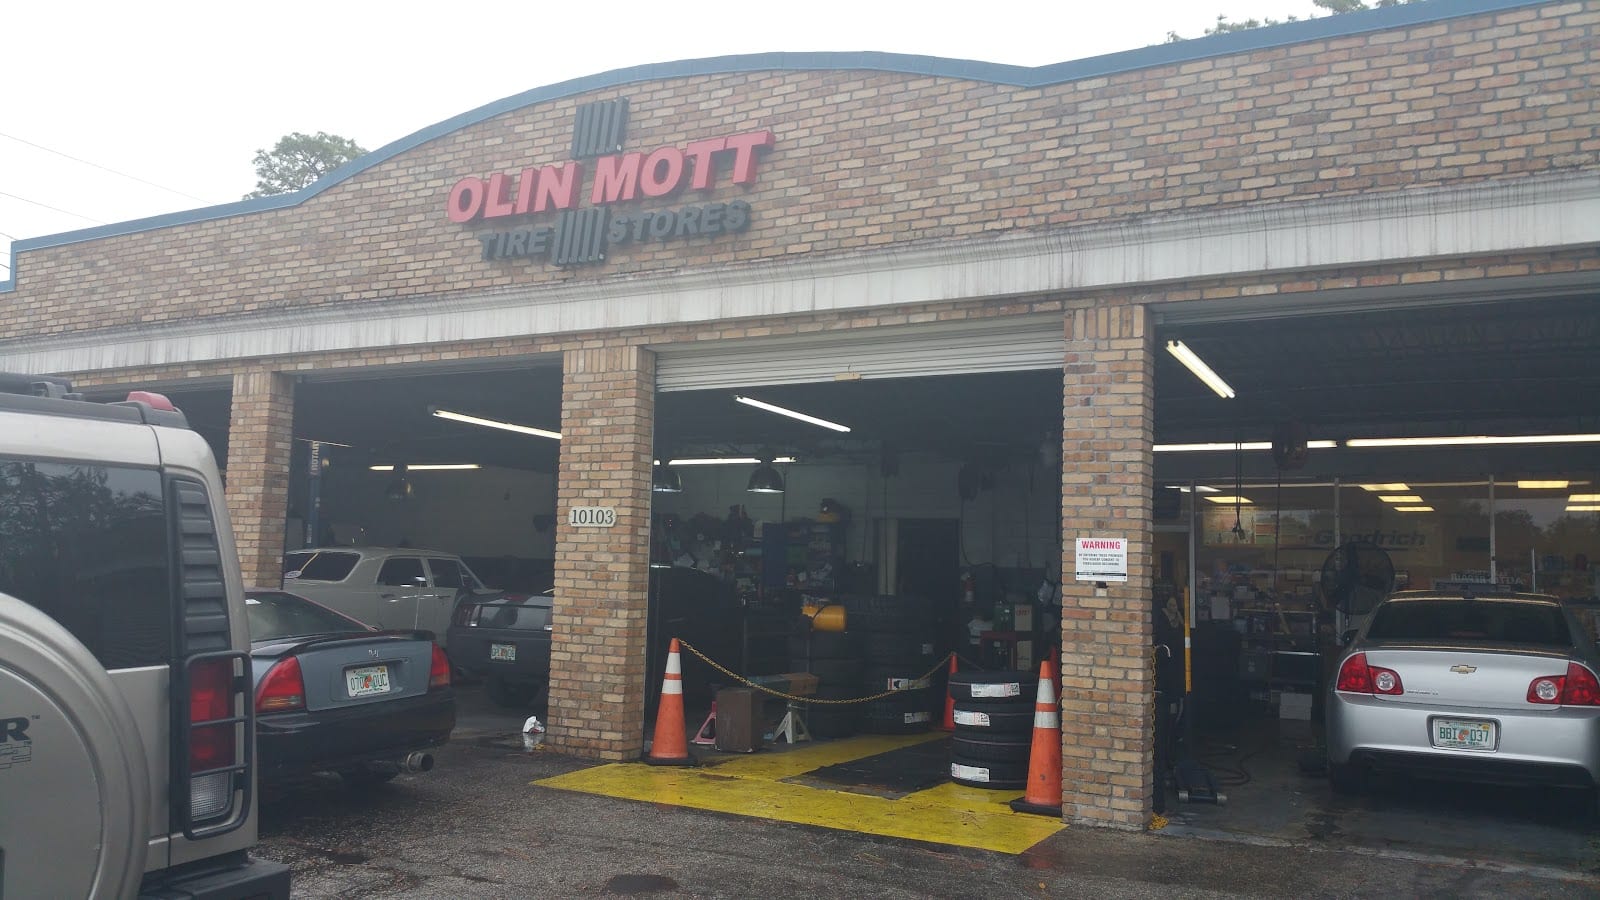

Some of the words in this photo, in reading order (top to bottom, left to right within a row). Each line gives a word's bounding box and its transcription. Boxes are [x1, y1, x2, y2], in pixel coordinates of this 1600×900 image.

[447, 161, 583, 223] OLIN
[590, 130, 776, 205] MOTT
[480, 226, 554, 261] TIRE
[607, 199, 752, 245] STORES
[571, 509, 614, 525] 10103
[1081, 540, 1121, 550] WARNING
